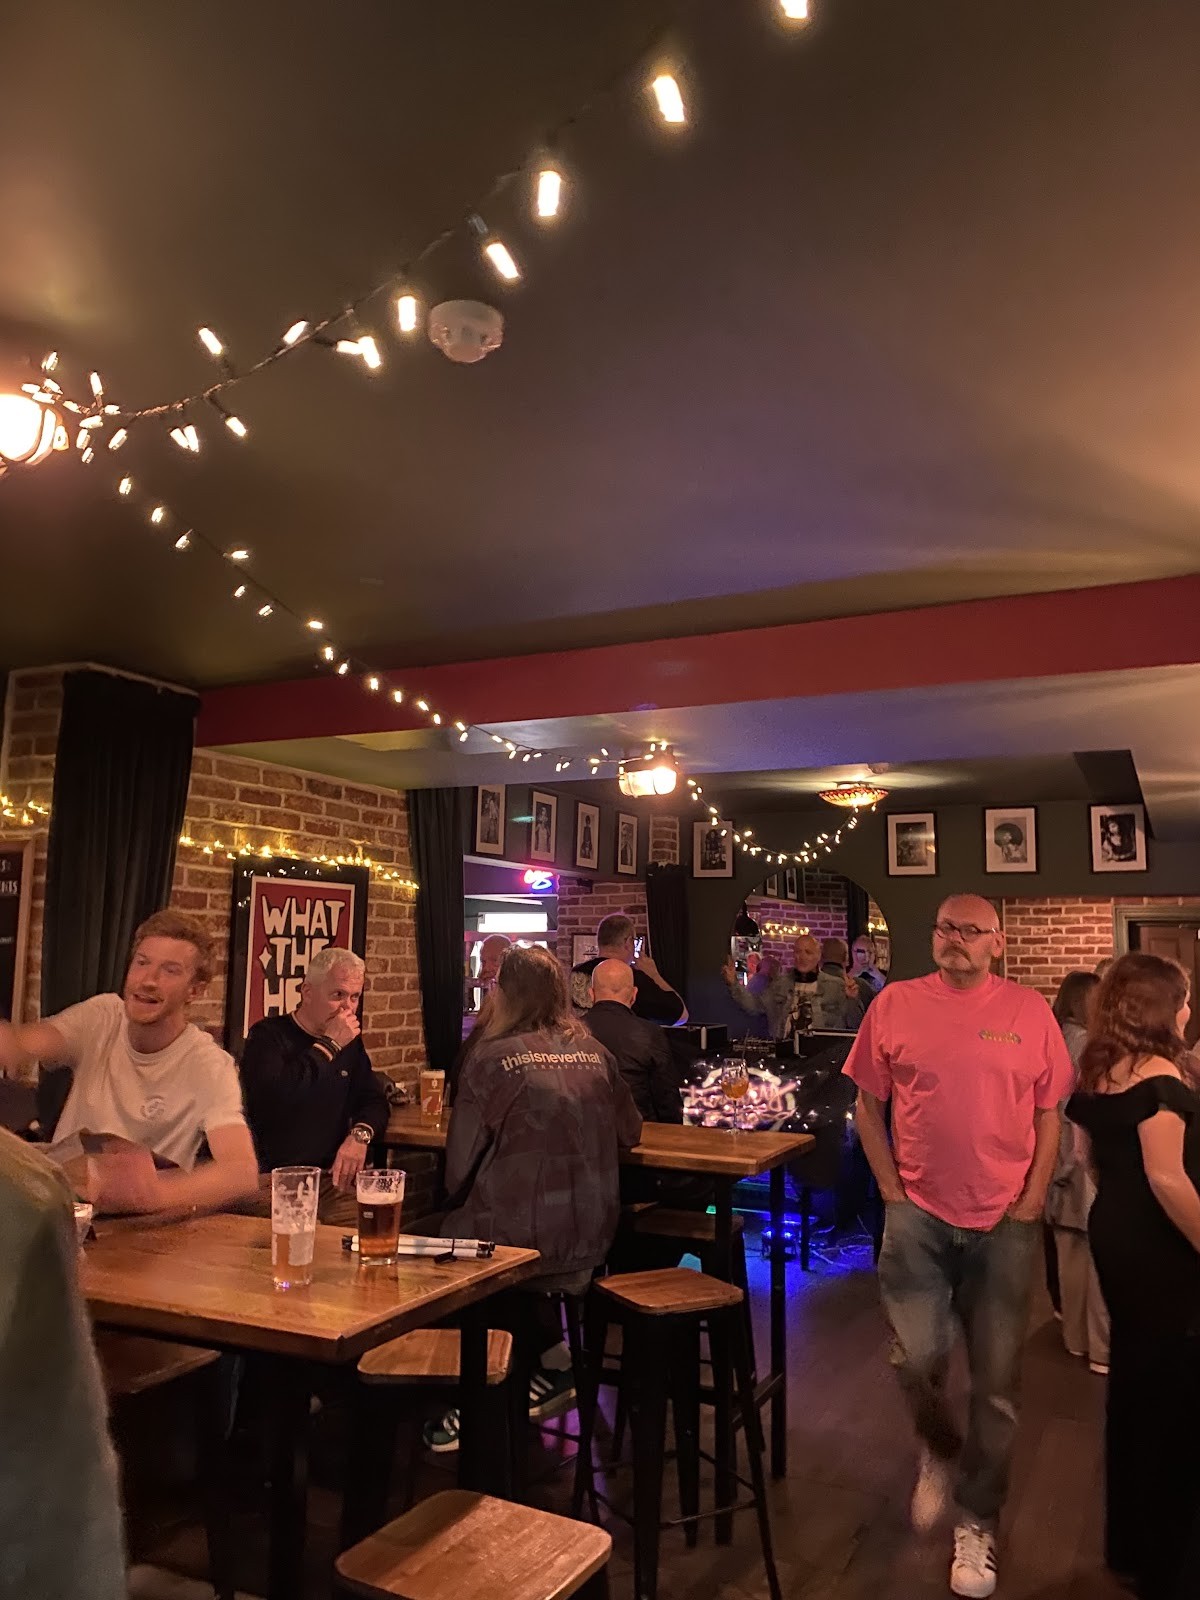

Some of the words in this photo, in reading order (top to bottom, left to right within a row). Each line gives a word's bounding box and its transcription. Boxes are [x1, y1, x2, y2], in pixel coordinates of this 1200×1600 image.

[262, 895, 345, 937] WHAT
[264, 977, 303, 1017] HE
[501, 1050, 602, 1072] thisisneverthat
[508, 1063, 603, 1078] INTERNATIONAL
